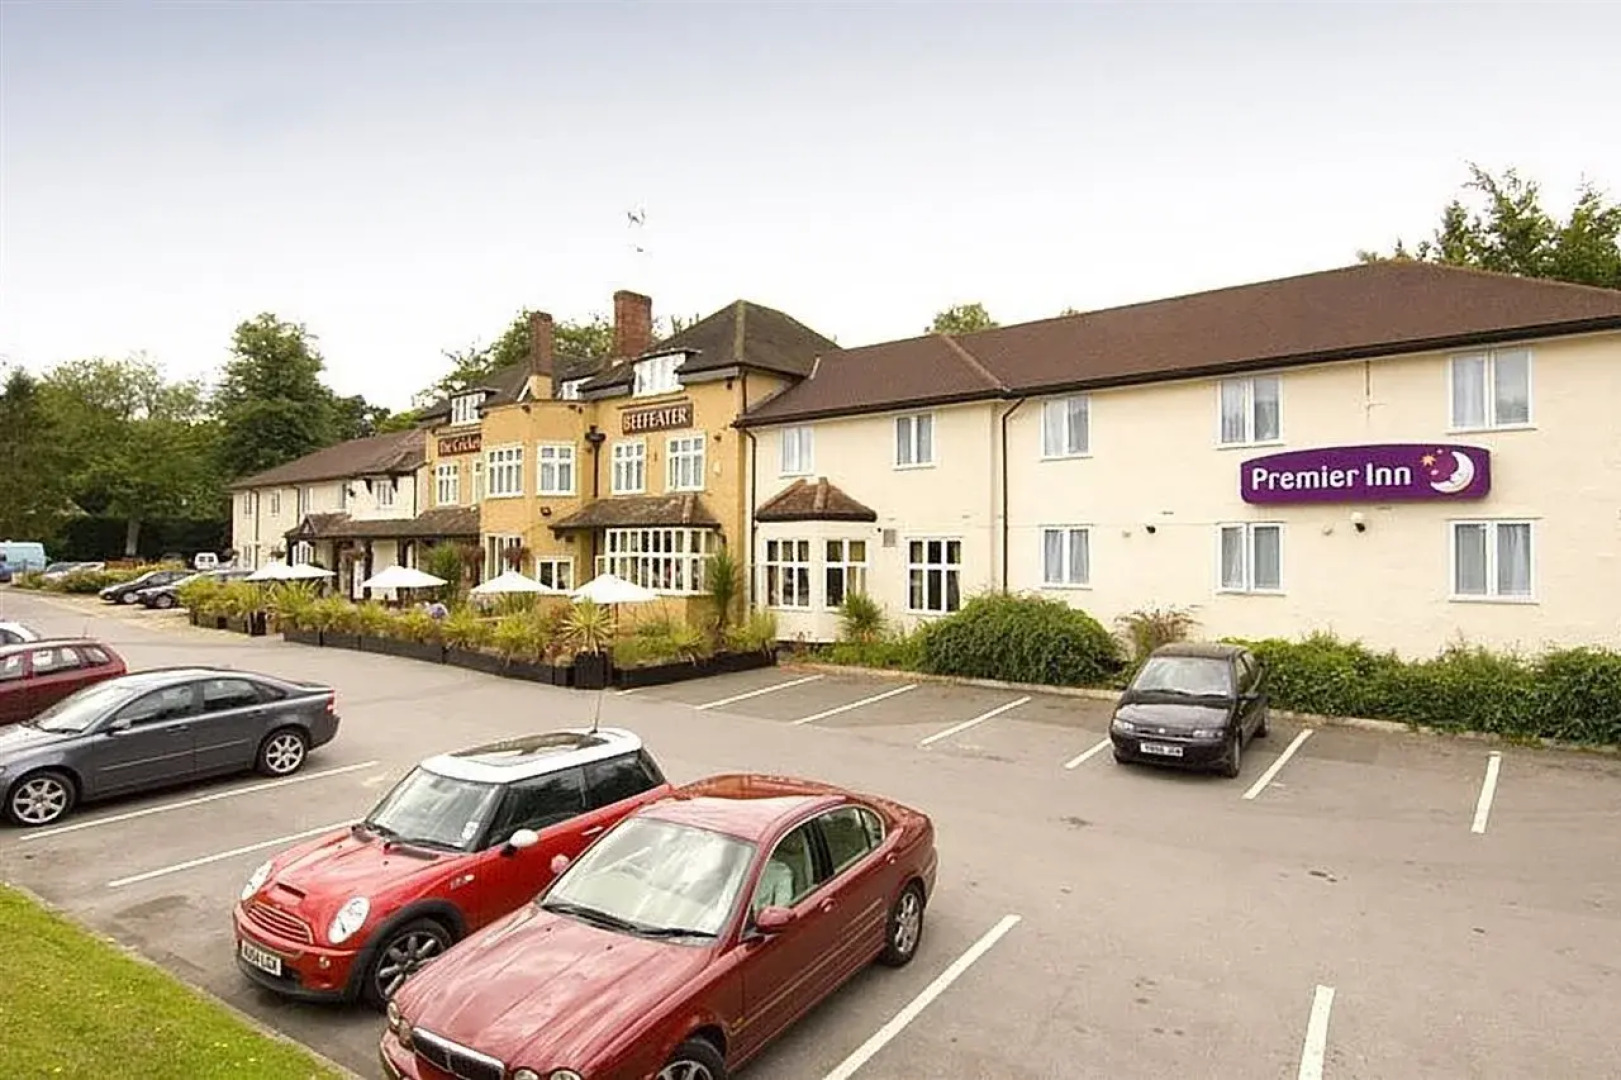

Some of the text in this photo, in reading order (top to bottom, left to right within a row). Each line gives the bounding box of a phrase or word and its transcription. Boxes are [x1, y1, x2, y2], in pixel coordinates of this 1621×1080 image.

[622, 408, 687, 431] BEEFEATER
[1252, 463, 1412, 490] Premier Inn
